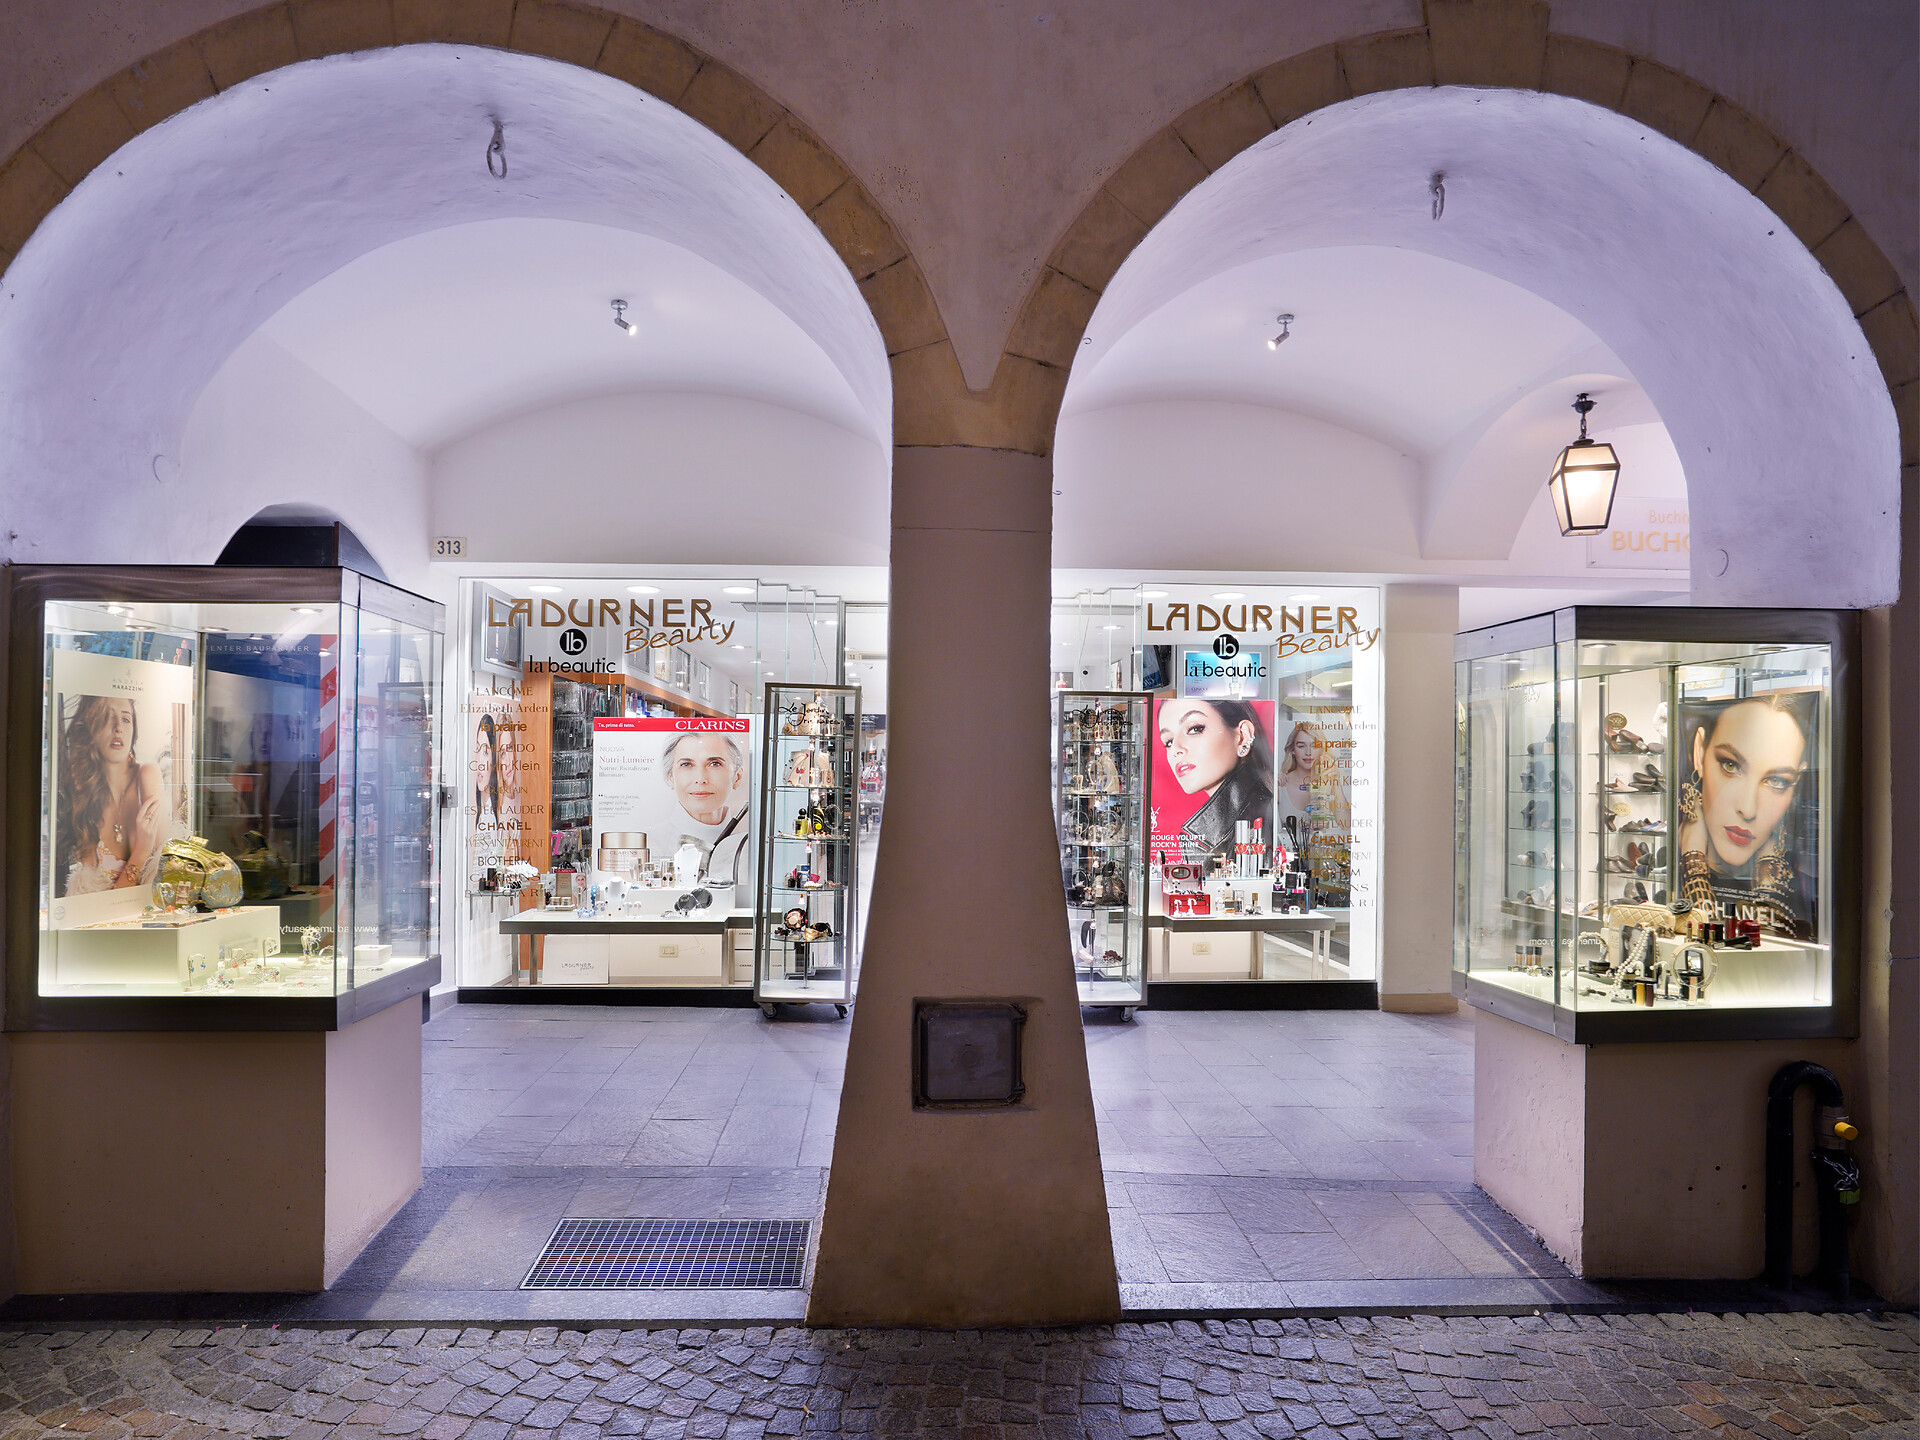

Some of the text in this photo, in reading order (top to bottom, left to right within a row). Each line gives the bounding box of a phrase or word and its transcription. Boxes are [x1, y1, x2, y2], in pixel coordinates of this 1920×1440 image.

[436, 540, 461, 555] 313
[487, 598, 713, 628] LADURNER
[1146, 603, 1359, 634] LADURNER
[624, 618, 736, 654] Beauty
[1275, 626, 1381, 659] Beauty
[528, 655, 617, 674] la beautic
[1184, 658, 1198, 677] la
[1202, 660, 1267, 677] beautic
[112, 684, 144, 692] MARAZZINI
[460, 703, 549, 713] Elizabeth Arden
[492, 721, 528, 736] prairie
[675, 720, 746, 731] CLARINS
[1346, 721, 1377, 730] Arden
[1325, 738, 1358, 752] prairie
[511, 760, 540, 771] Klein
[1303, 775, 1370, 786] Calvin Klein
[499, 804, 545, 815] LAUDER
[477, 821, 532, 831] CHANEL
[1310, 834, 1361, 845] CHANEL
[1701, 899, 1782, 928] CHNEL
